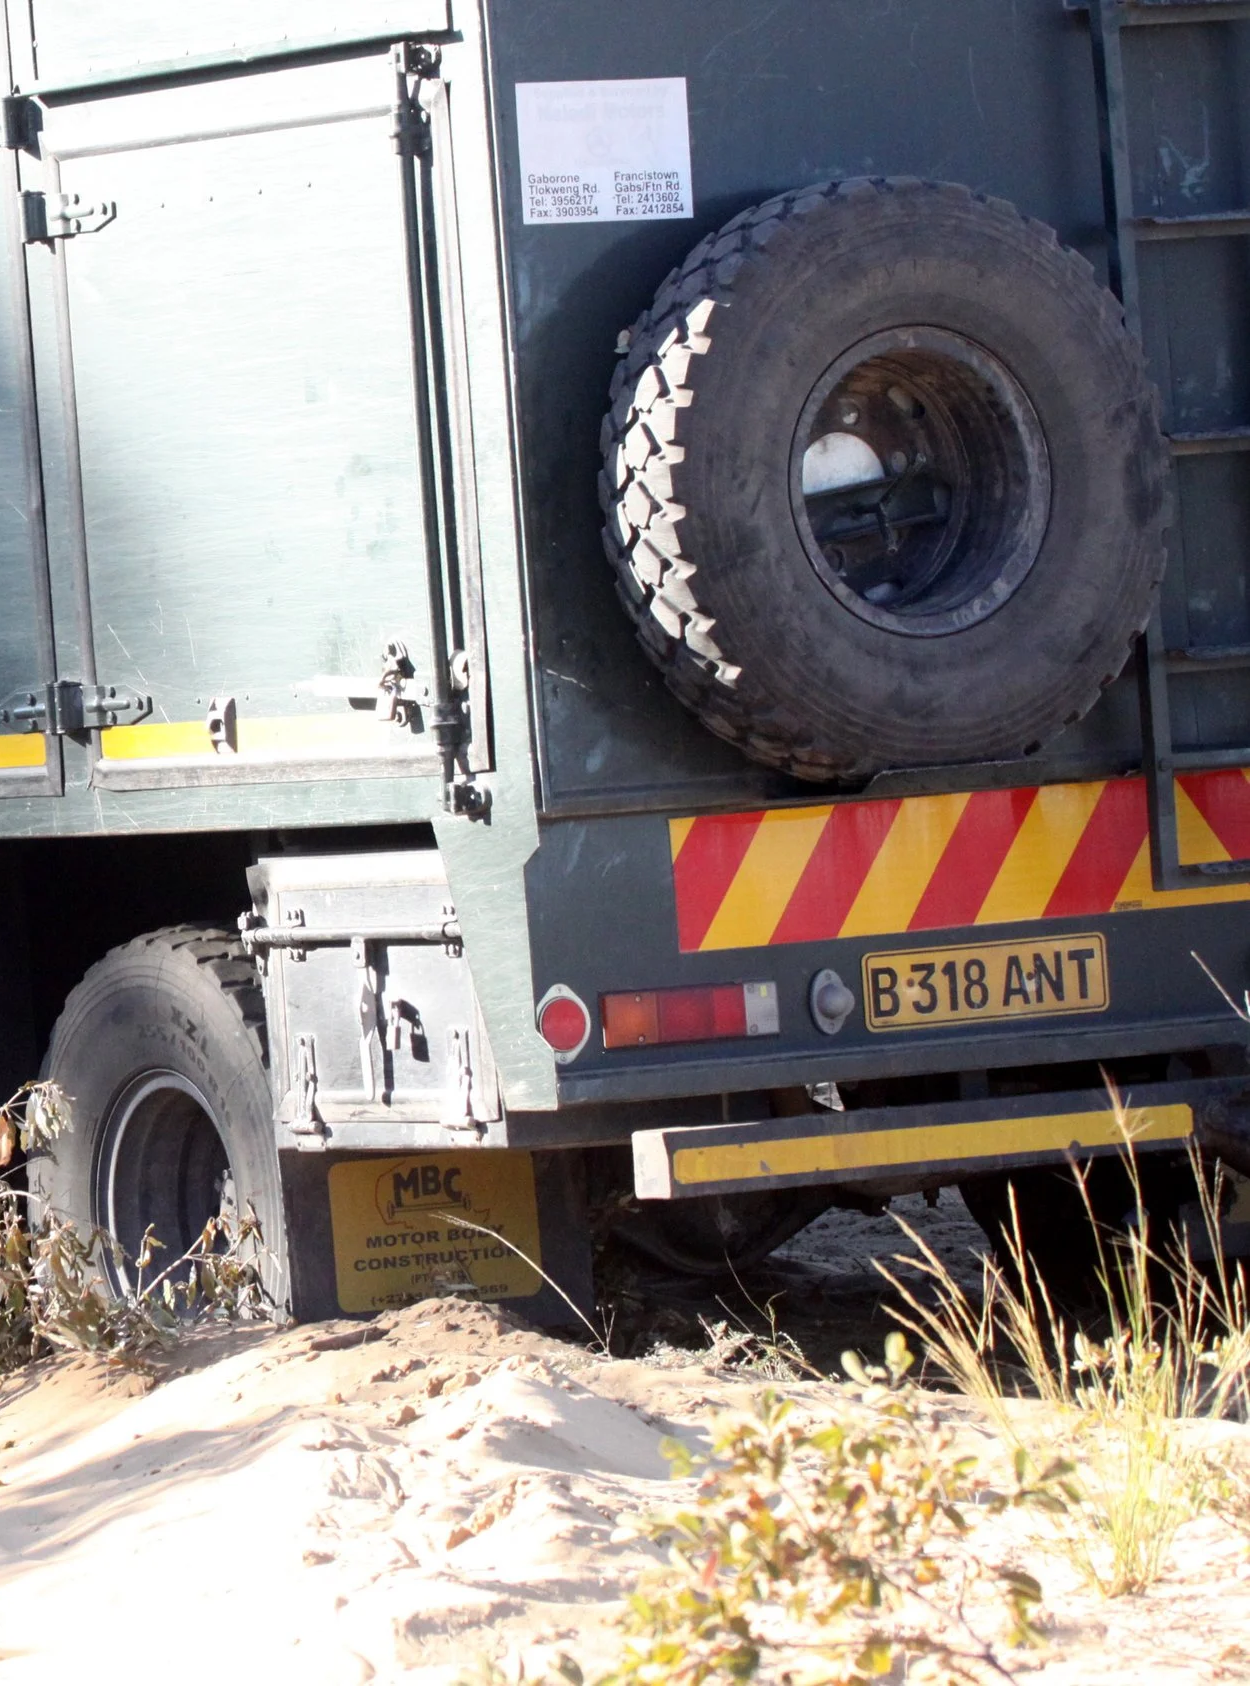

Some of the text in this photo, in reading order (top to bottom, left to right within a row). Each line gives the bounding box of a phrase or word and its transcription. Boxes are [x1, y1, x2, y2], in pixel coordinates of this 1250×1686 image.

[528, 174, 580, 184] Gaborone
[614, 170, 679, 181] Francistown
[528, 183, 600, 197] Tlokweng Rd.
[615, 181, 683, 193] Gabs/Ftn Rd.
[529, 194, 594, 207] Tel: 3956217
[615, 192, 680, 204] Tel: 2413602
[530, 205, 598, 218] Fax: 3903954
[616, 203, 684, 215] Fax: 2412854
[870, 948, 1095, 1018] B 318 ANT
[393, 1166, 464, 1207] MBC
[366, 1223, 505, 1249] MOTOR BODY
[353, 1245, 522, 1273] CONSTRUCTION
